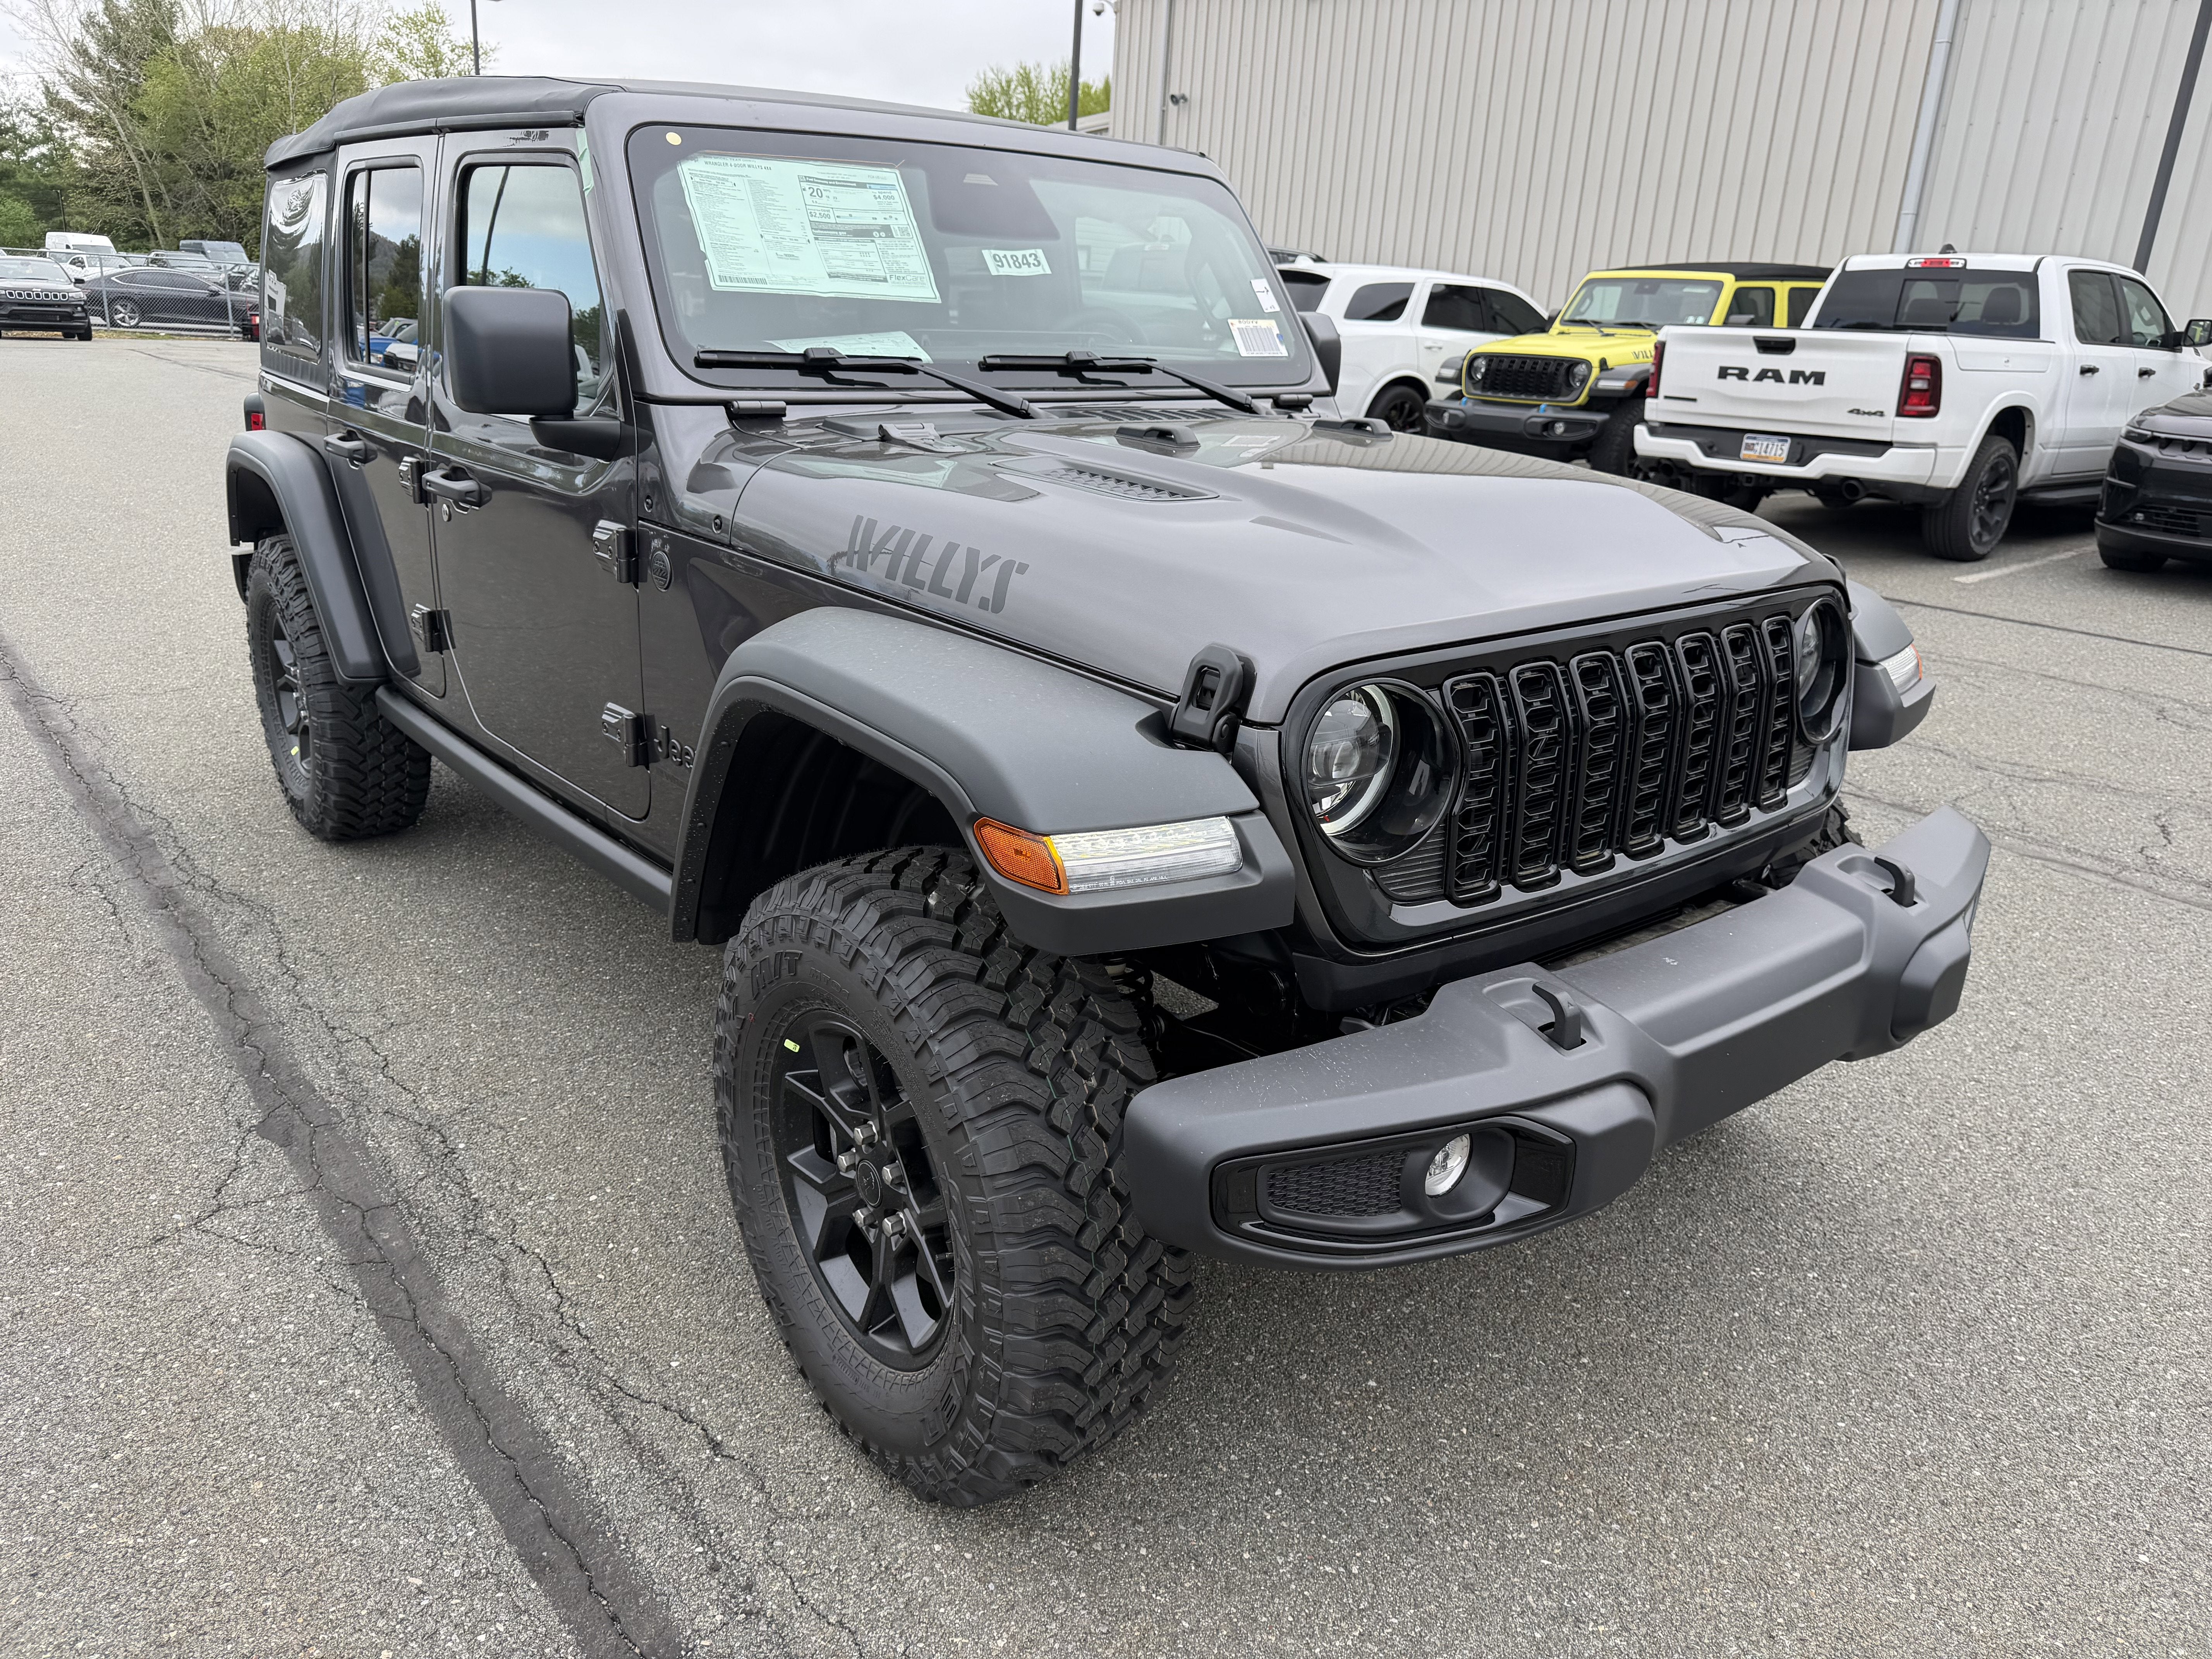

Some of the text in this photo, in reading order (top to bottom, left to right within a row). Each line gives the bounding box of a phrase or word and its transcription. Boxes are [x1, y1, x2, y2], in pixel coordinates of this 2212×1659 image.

[808, 187, 823, 198] 20
[993, 252, 1041, 269] 91843
[1717, 366, 1826, 386] RAM
[846, 515, 1029, 614] WILLYS
[654, 725, 696, 768] Jee
